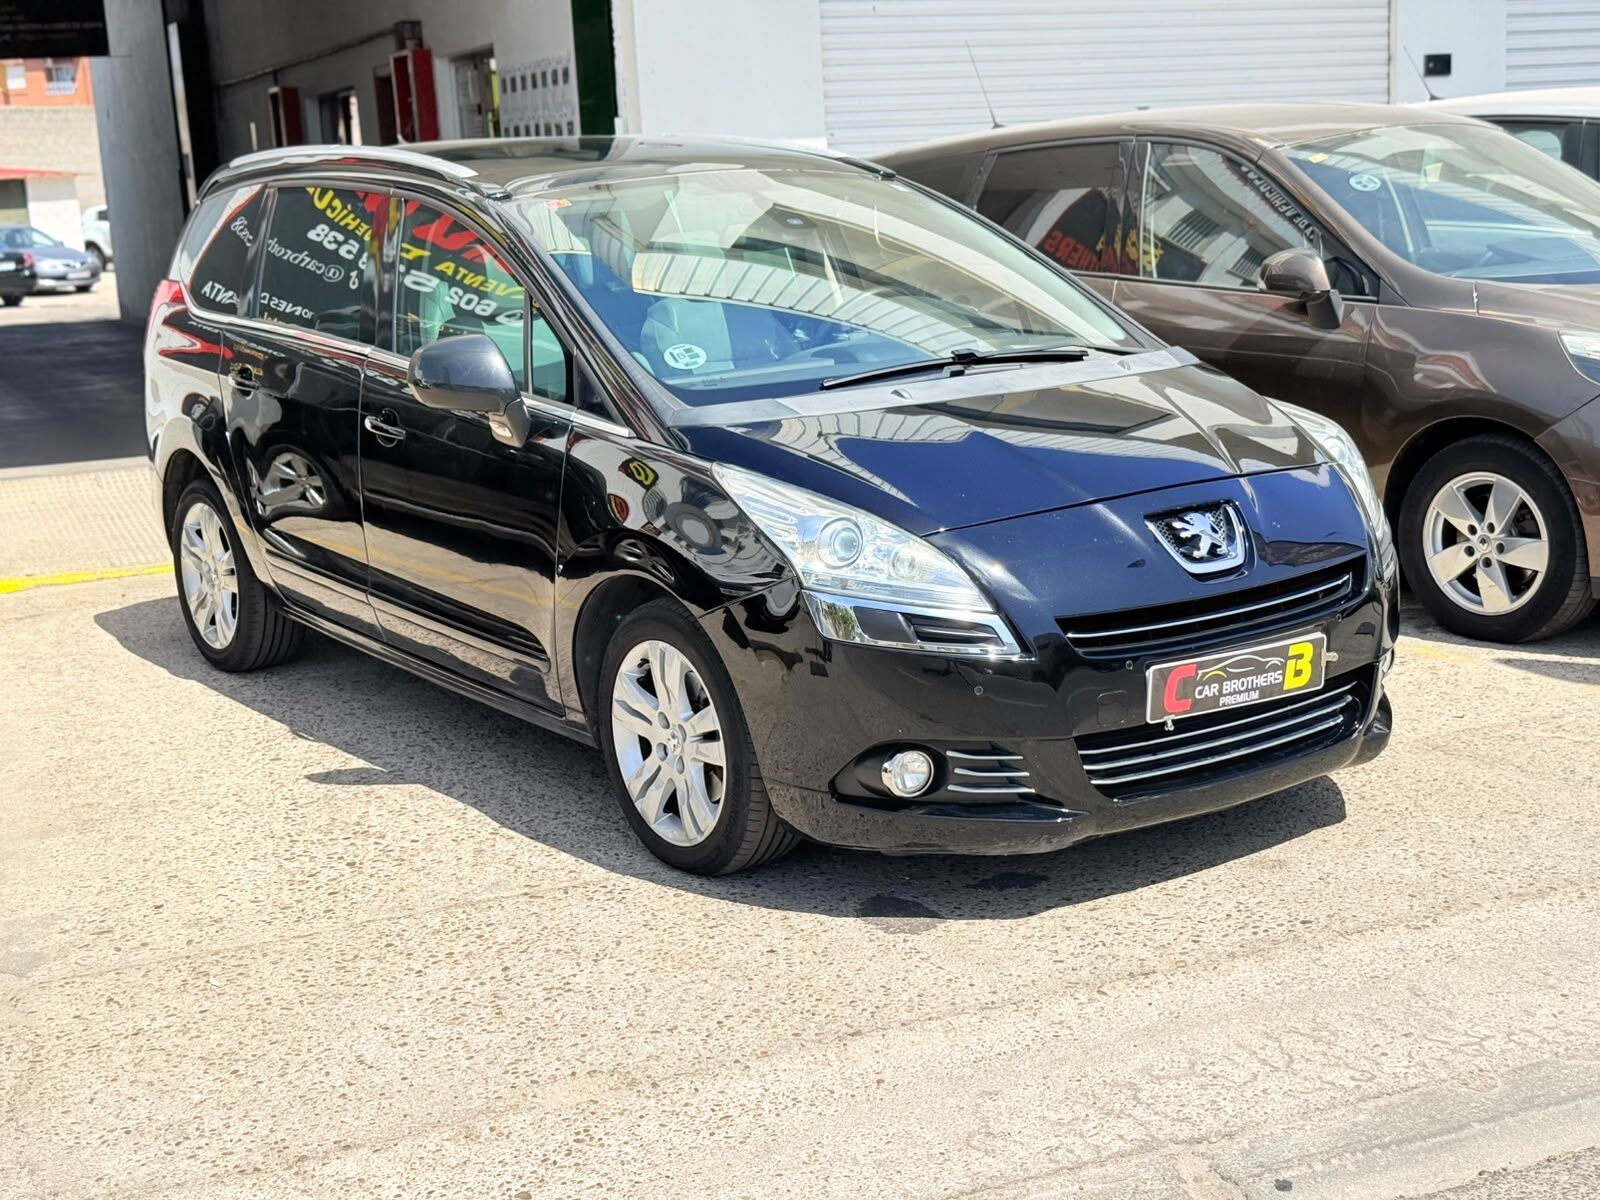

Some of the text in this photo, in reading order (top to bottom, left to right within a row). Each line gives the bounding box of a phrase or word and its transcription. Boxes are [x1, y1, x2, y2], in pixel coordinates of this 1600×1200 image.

[1194, 670, 1283, 699] CAR BROTHERS
[1219, 690, 1259, 706] PREMIUM
